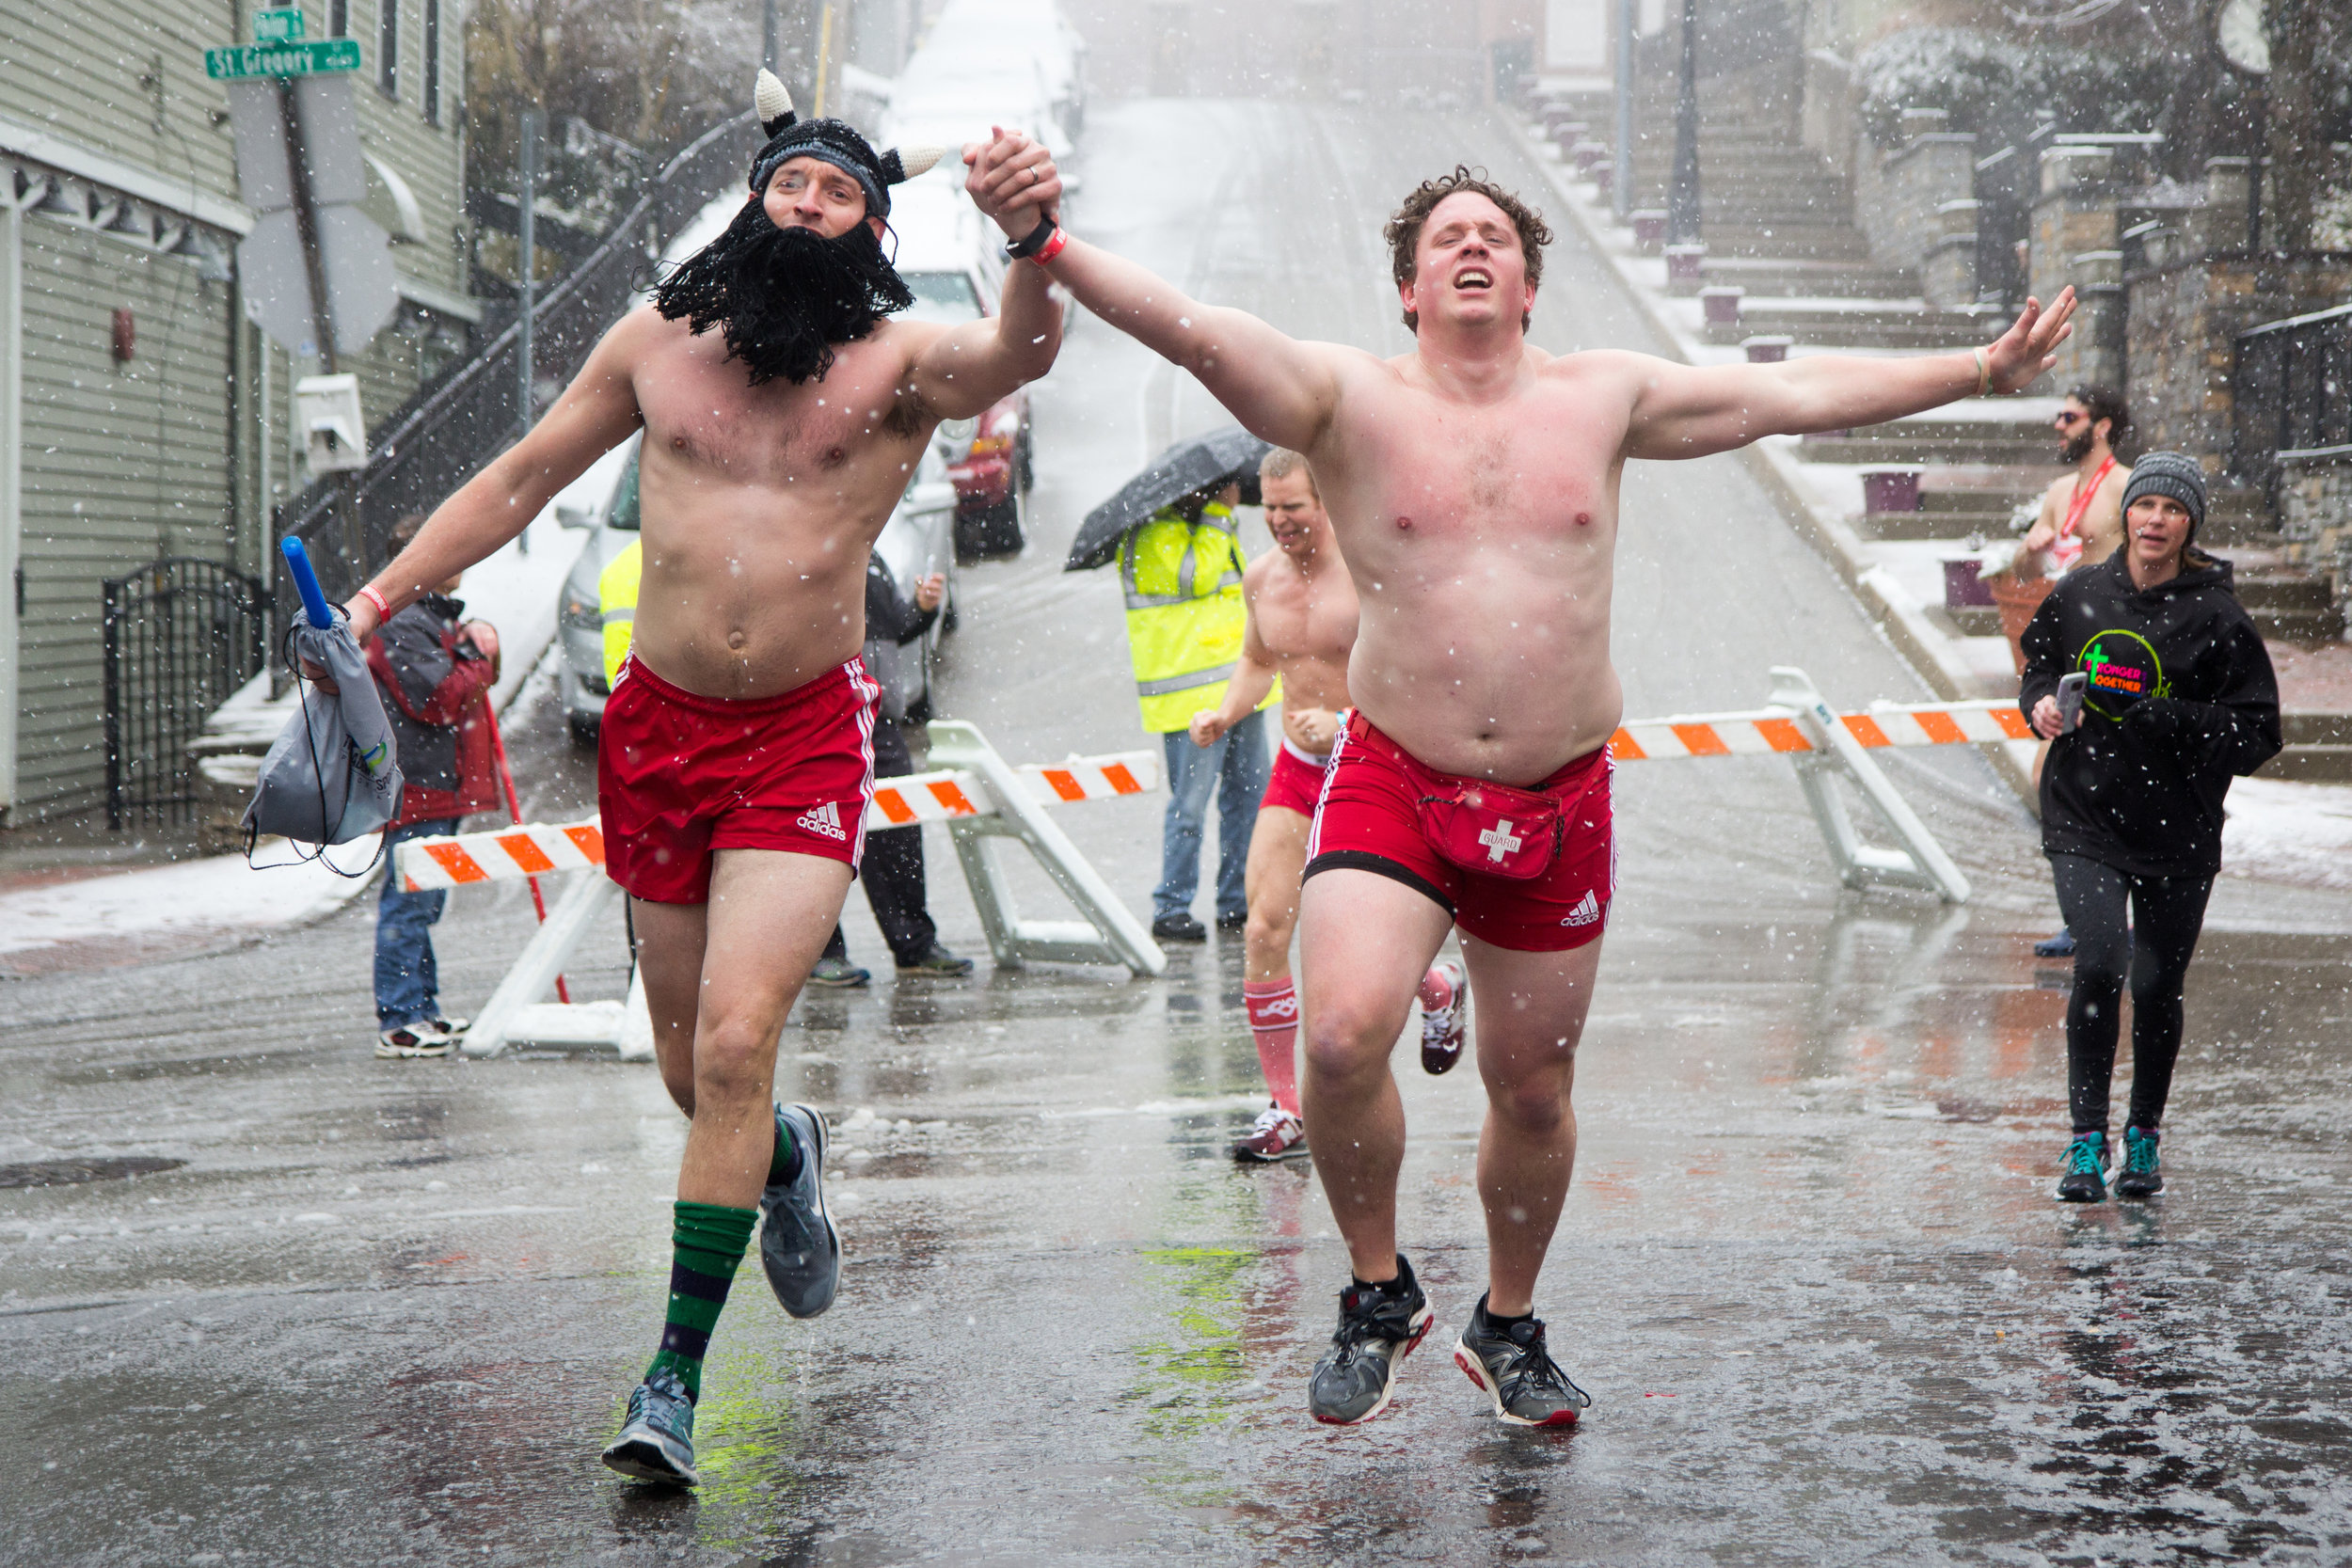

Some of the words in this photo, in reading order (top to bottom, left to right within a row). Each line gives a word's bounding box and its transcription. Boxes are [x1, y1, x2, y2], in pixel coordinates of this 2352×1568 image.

[242, 47, 313, 75] Gregory
[797, 816, 847, 841] adidas
[1484, 832, 1518, 849] GUARD
[1560, 911, 1600, 927] adidas
